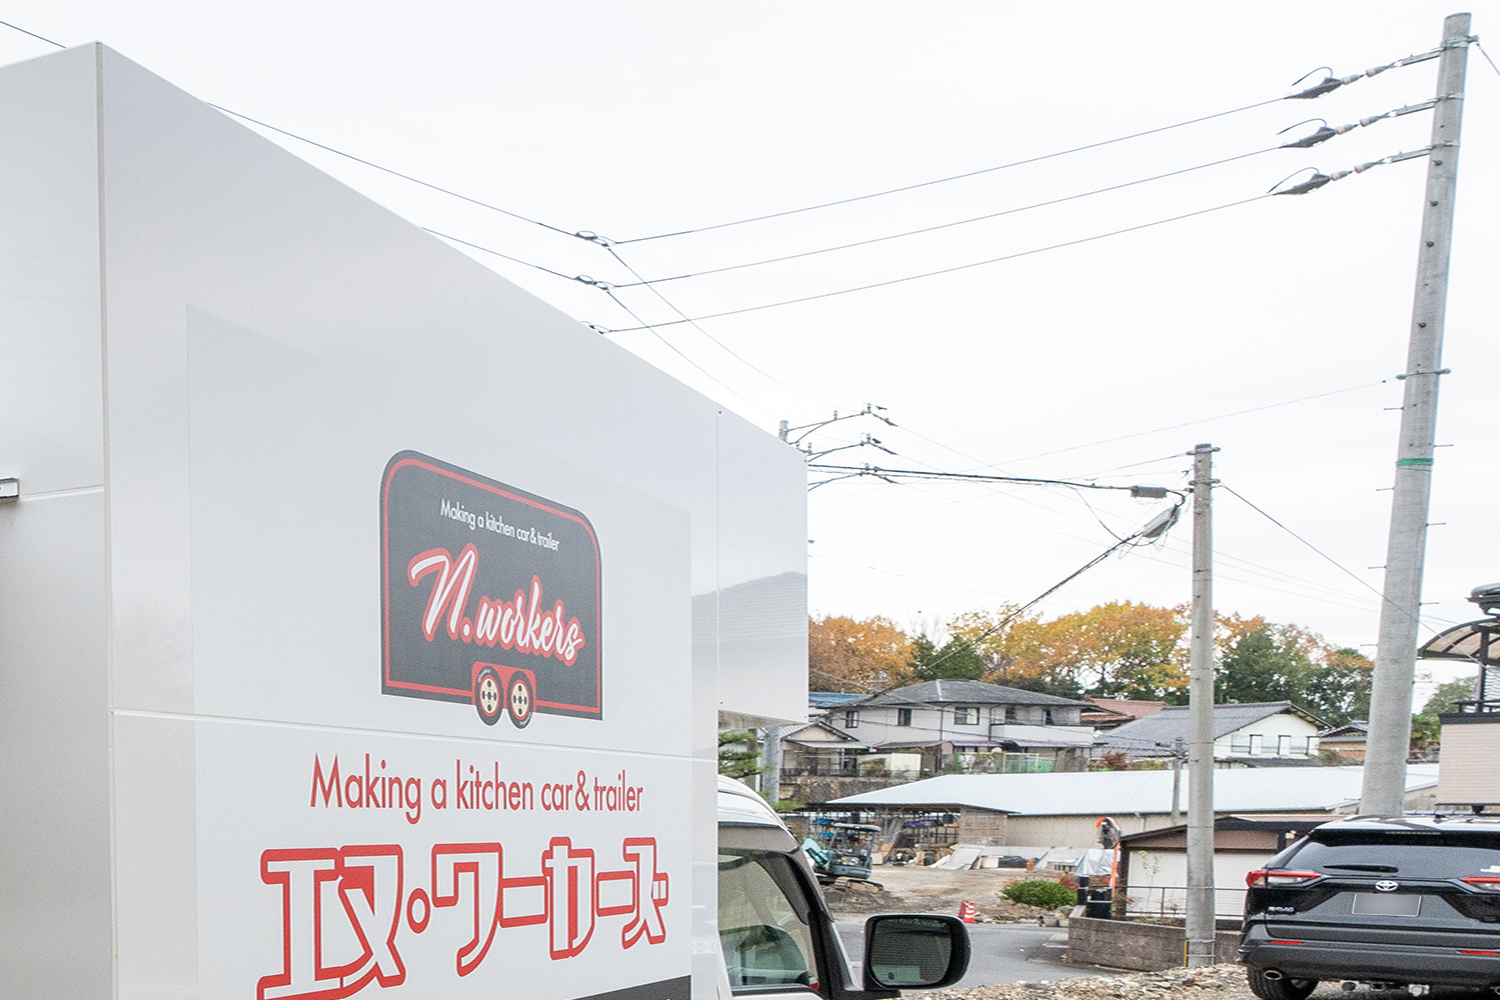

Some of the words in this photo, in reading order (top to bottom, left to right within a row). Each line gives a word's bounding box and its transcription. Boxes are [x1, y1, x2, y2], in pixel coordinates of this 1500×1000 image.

[440, 498, 475, 531] Making
[477, 515, 485, 528] a
[485, 511, 515, 538] kitchen
[310, 753, 421, 825] Making
[430, 778, 447, 810] a
[456, 759, 534, 811] kitchen
[593, 770, 644, 812] trailer
